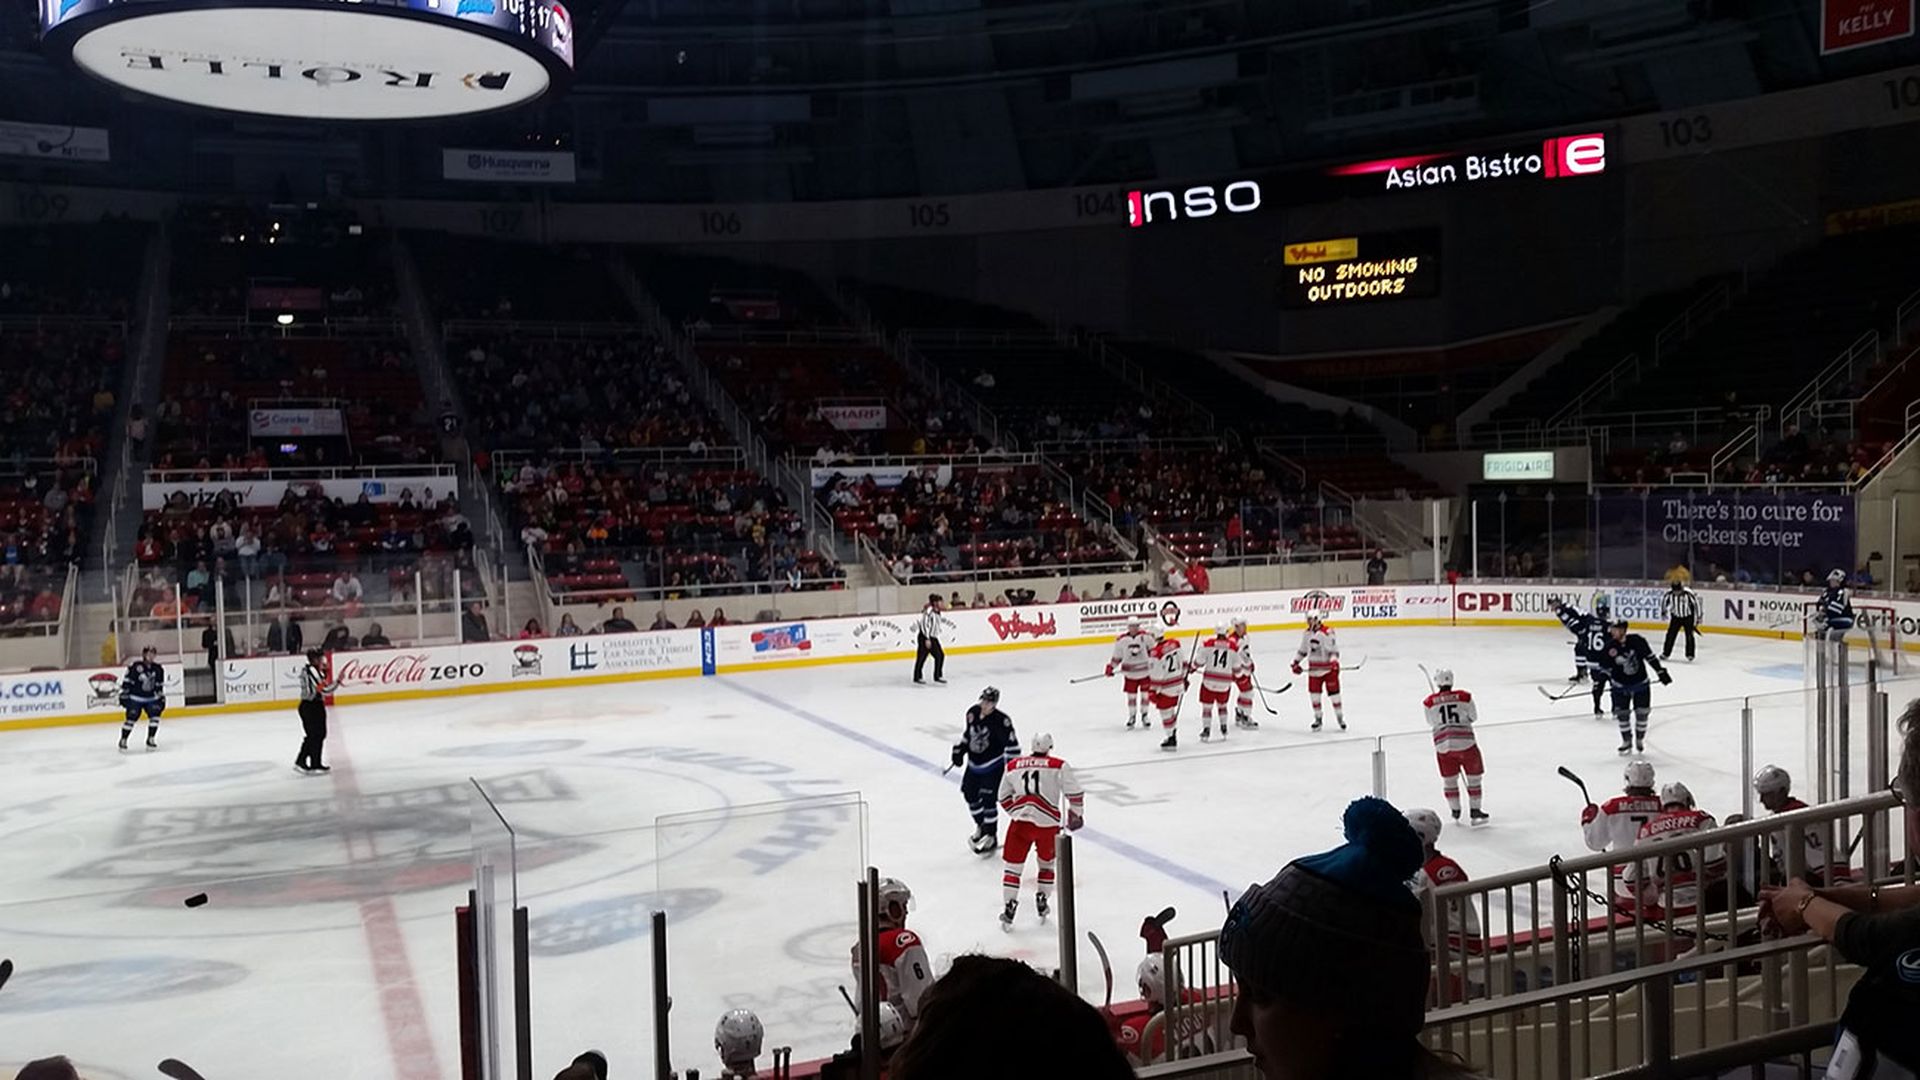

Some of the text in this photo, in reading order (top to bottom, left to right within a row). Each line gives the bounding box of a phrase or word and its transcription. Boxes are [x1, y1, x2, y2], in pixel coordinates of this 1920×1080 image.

[1838, 8, 1894, 37] KELLY
[1660, 116, 1712, 146] 103
[1386, 151, 1541, 189] Asian Bistro
[1075, 193, 1116, 216] 104
[700, 211, 741, 234] 106
[910, 204, 950, 226] 105
[1299, 257, 1418, 284] NO SMOKING
[1308, 277, 1405, 302] OUTDOORS
[824, 408, 880, 419] SHARP
[1487, 459, 1551, 472] FRIGIDAIRE
[1662, 500, 1843, 521] There's no cure for
[1663, 524, 1803, 547] Checkers fever
[1080, 601, 1157, 615] QUEEN CITY Q
[1352, 593, 1397, 605] AMERICA'S
[1405, 595, 1448, 605] CCM
[1458, 592, 1513, 612] CPI
[1759, 600, 1803, 612] NOVAN
[1353, 604, 1397, 618] PULSE
[1587, 631, 1605, 651] 16
[1212, 648, 1228, 668] 14
[430, 662, 484, 681] zero
[226, 680, 271, 695] berger
[12, 702, 66, 712] SERVICES
[1438, 704, 1460, 724] 15
[1022, 769, 1040, 795] 11
[1651, 816, 1698, 834] GIUSEPPE
[912, 962, 924, 980] 6
